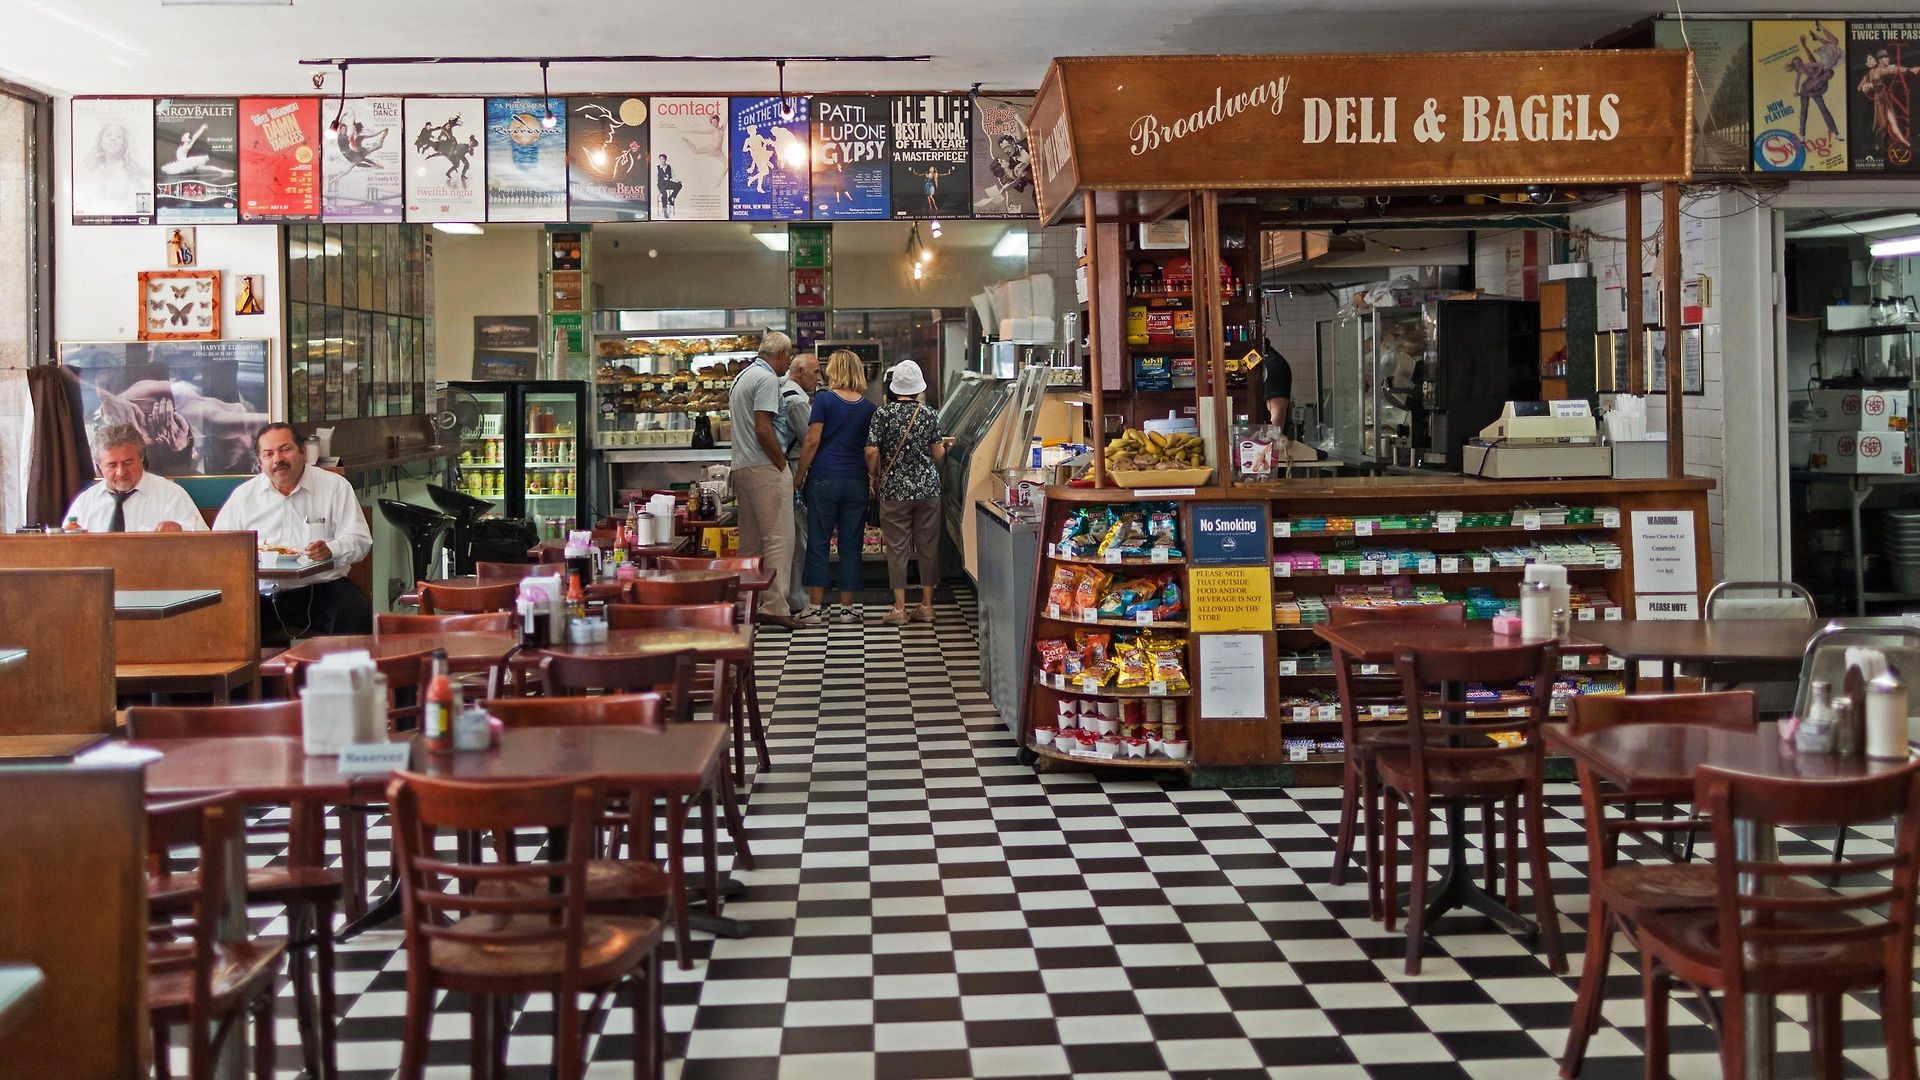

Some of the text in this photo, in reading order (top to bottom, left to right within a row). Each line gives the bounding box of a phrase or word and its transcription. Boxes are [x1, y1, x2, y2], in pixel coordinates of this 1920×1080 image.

[1852, 30, 1880, 40] TWICE
[1882, 30, 1898, 40] THE
[658, 102, 720, 116] contact
[819, 102, 866, 122] PATTI
[1766, 99, 1784, 113] NOW
[744, 112, 755, 125] ON
[756, 106, 772, 122] THE
[1128, 75, 1291, 155] Broadway
[1302, 97, 1398, 144] DELI
[1413, 97, 1448, 144] &
[1462, 94, 1620, 142] BAGELS
[1764, 106, 1794, 124] PLAYING
[263, 113, 300, 140] DAMN
[921, 122, 966, 140] MUSICAL
[270, 130, 304, 152] YANKEES
[896, 140, 910, 149] OF
[912, 140, 932, 148] THE
[1764, 130, 1832, 164] Swng!
[822, 140, 885, 164] GYPSY
[417, 187, 473, 198] twelfth night
[616, 182, 644, 194] BEAST
[1200, 518, 1257, 533] No Smoking
[1647, 516, 1678, 525] WARNING!
[1649, 603, 1687, 612] PLEASE NOTE
[346, 753, 403, 762] Reserved
